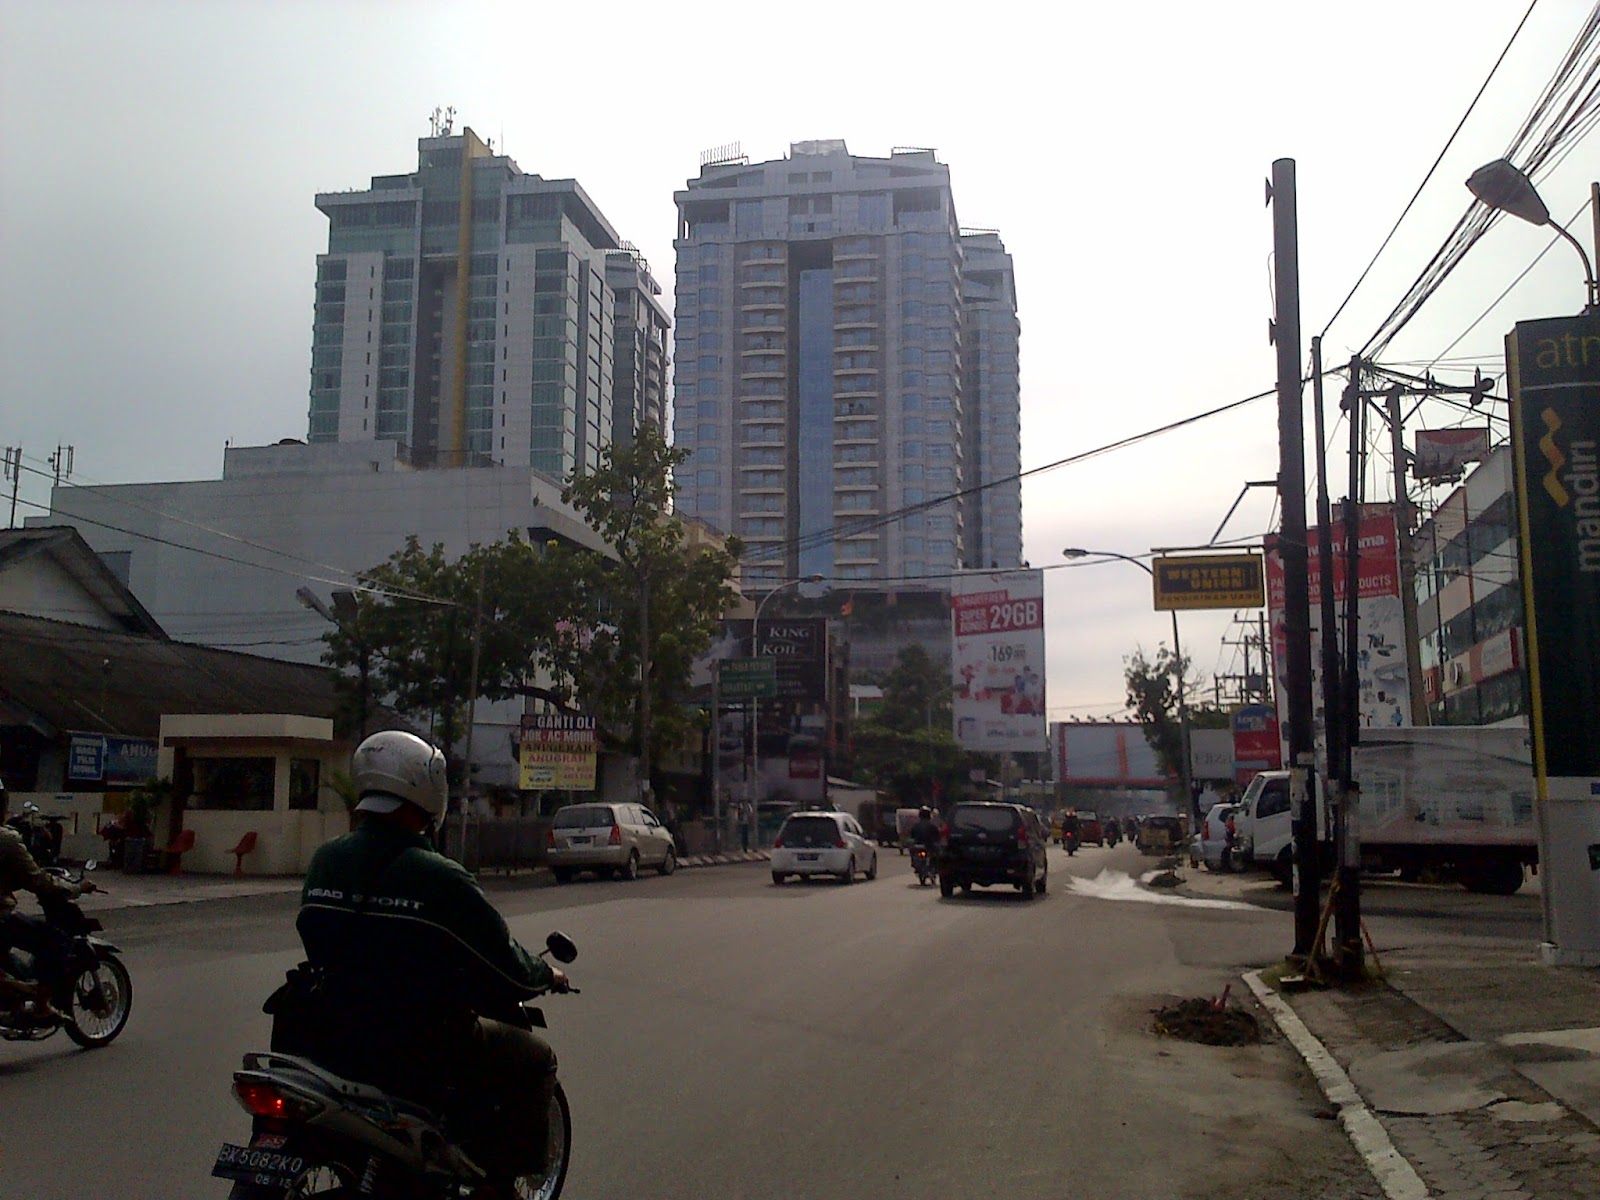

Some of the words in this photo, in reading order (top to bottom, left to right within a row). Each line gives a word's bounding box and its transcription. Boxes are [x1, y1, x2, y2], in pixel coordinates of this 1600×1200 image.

[1166, 567, 1244, 580] WESTERN
[1190, 577, 1244, 589] UNION
[960, 609, 987, 622] SUPER
[989, 601, 1038, 630] 29GB
[769, 626, 810, 638] KING
[762, 643, 799, 655] KOIL
[991, 645, 1014, 662] 169
[537, 715, 574, 730] GANTI
[576, 716, 596, 730] OLI
[547, 730, 561, 743] AC
[563, 729, 595, 743] MOBIL
[308, 888, 344, 899] HEAD
[352, 893, 425, 910] SPORT
